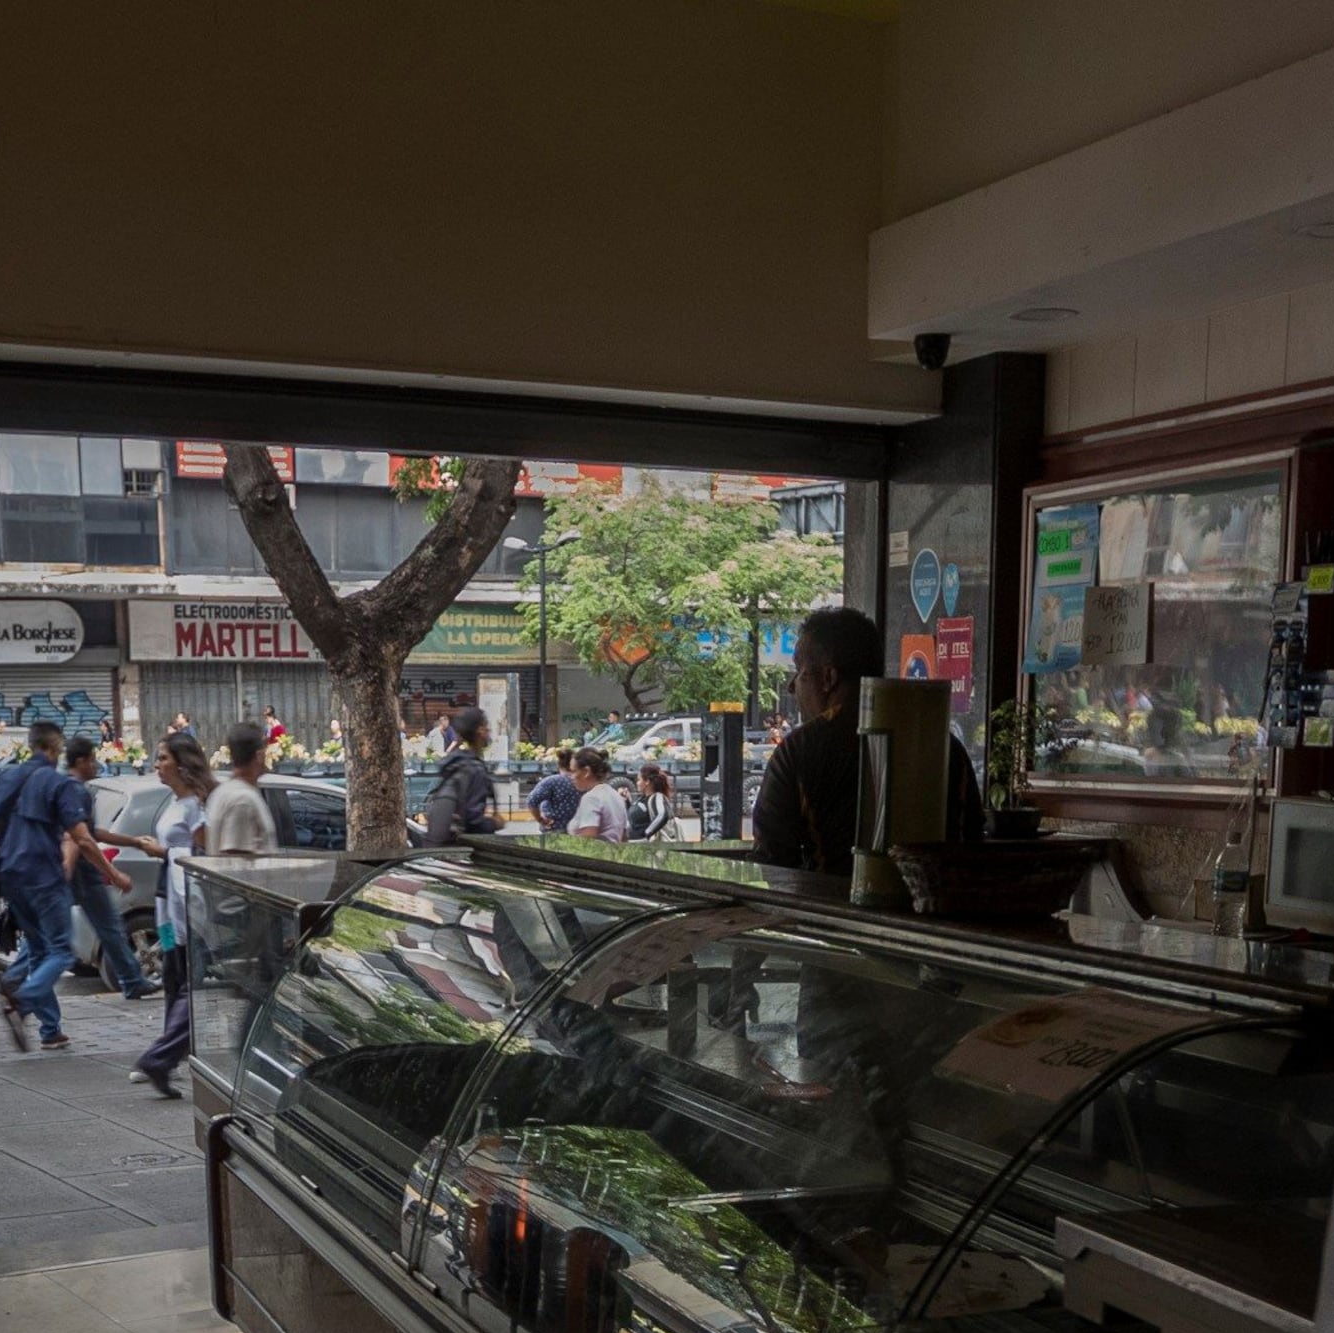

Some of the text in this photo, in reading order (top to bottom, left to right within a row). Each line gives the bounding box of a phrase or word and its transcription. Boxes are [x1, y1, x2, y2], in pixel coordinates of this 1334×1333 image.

[174, 603, 293, 620] ELECTRODOMESTIC
[175, 621, 309, 658] MARTELL
[447, 631, 467, 646] LA
